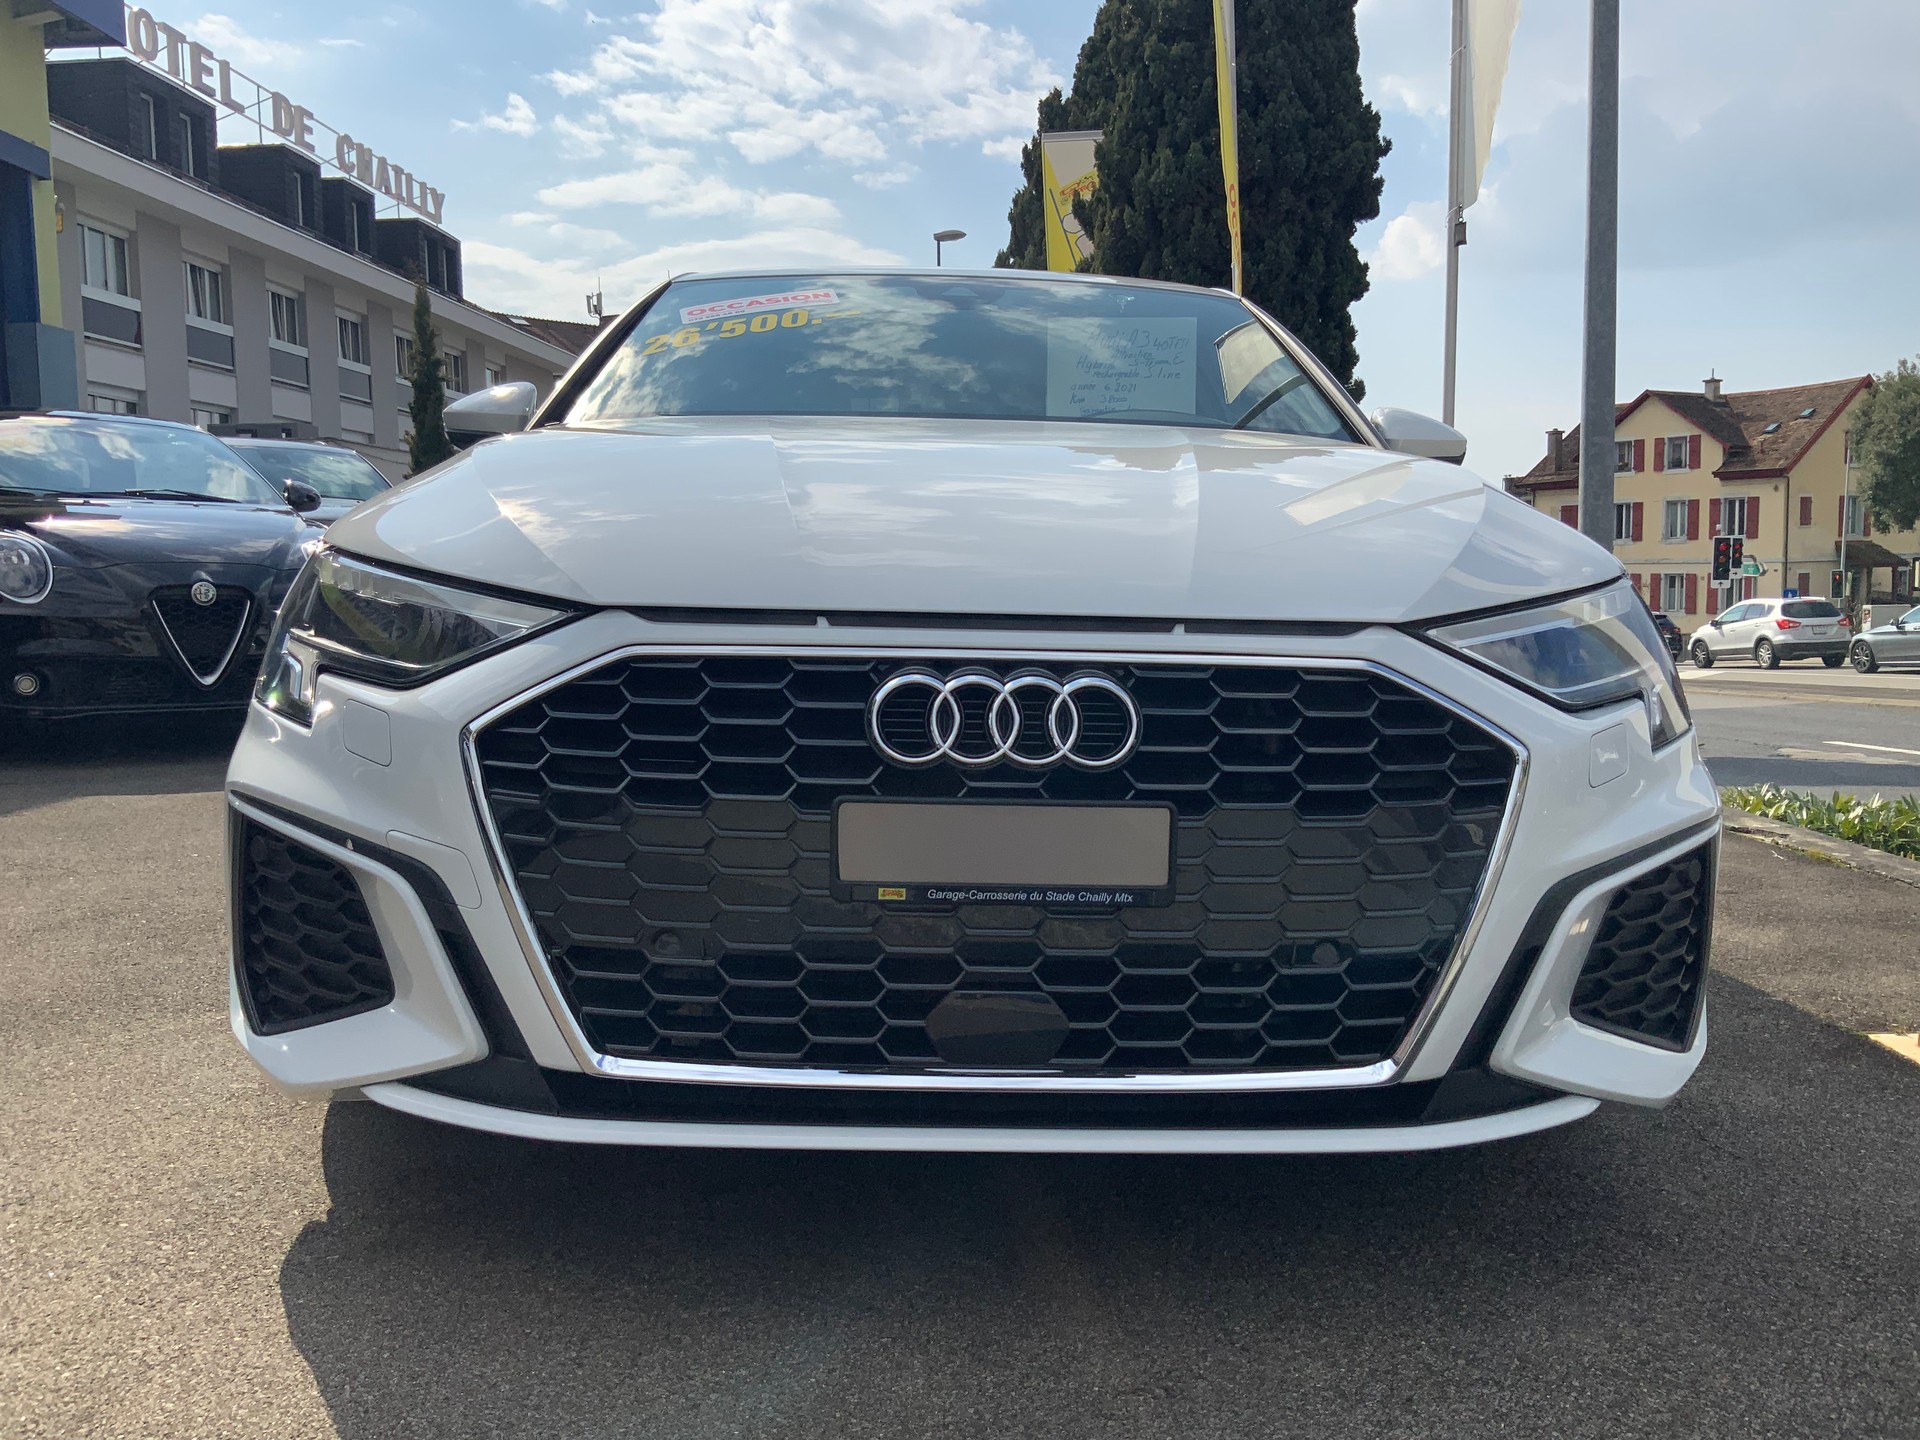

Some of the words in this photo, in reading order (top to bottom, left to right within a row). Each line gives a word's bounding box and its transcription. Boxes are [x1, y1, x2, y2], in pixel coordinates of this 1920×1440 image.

[272, 91, 316, 153] DE
[336, 133, 446, 224] CHAILLY
[686, 292, 832, 317] OCCASION
[927, 888, 1027, 901] Garage-Carrosserie
[1030, 891, 1043, 900] du
[1046, 891, 1075, 901] Stade
[1078, 892, 1112, 904] Chailly
[1114, 893, 1133, 902] Mtx
